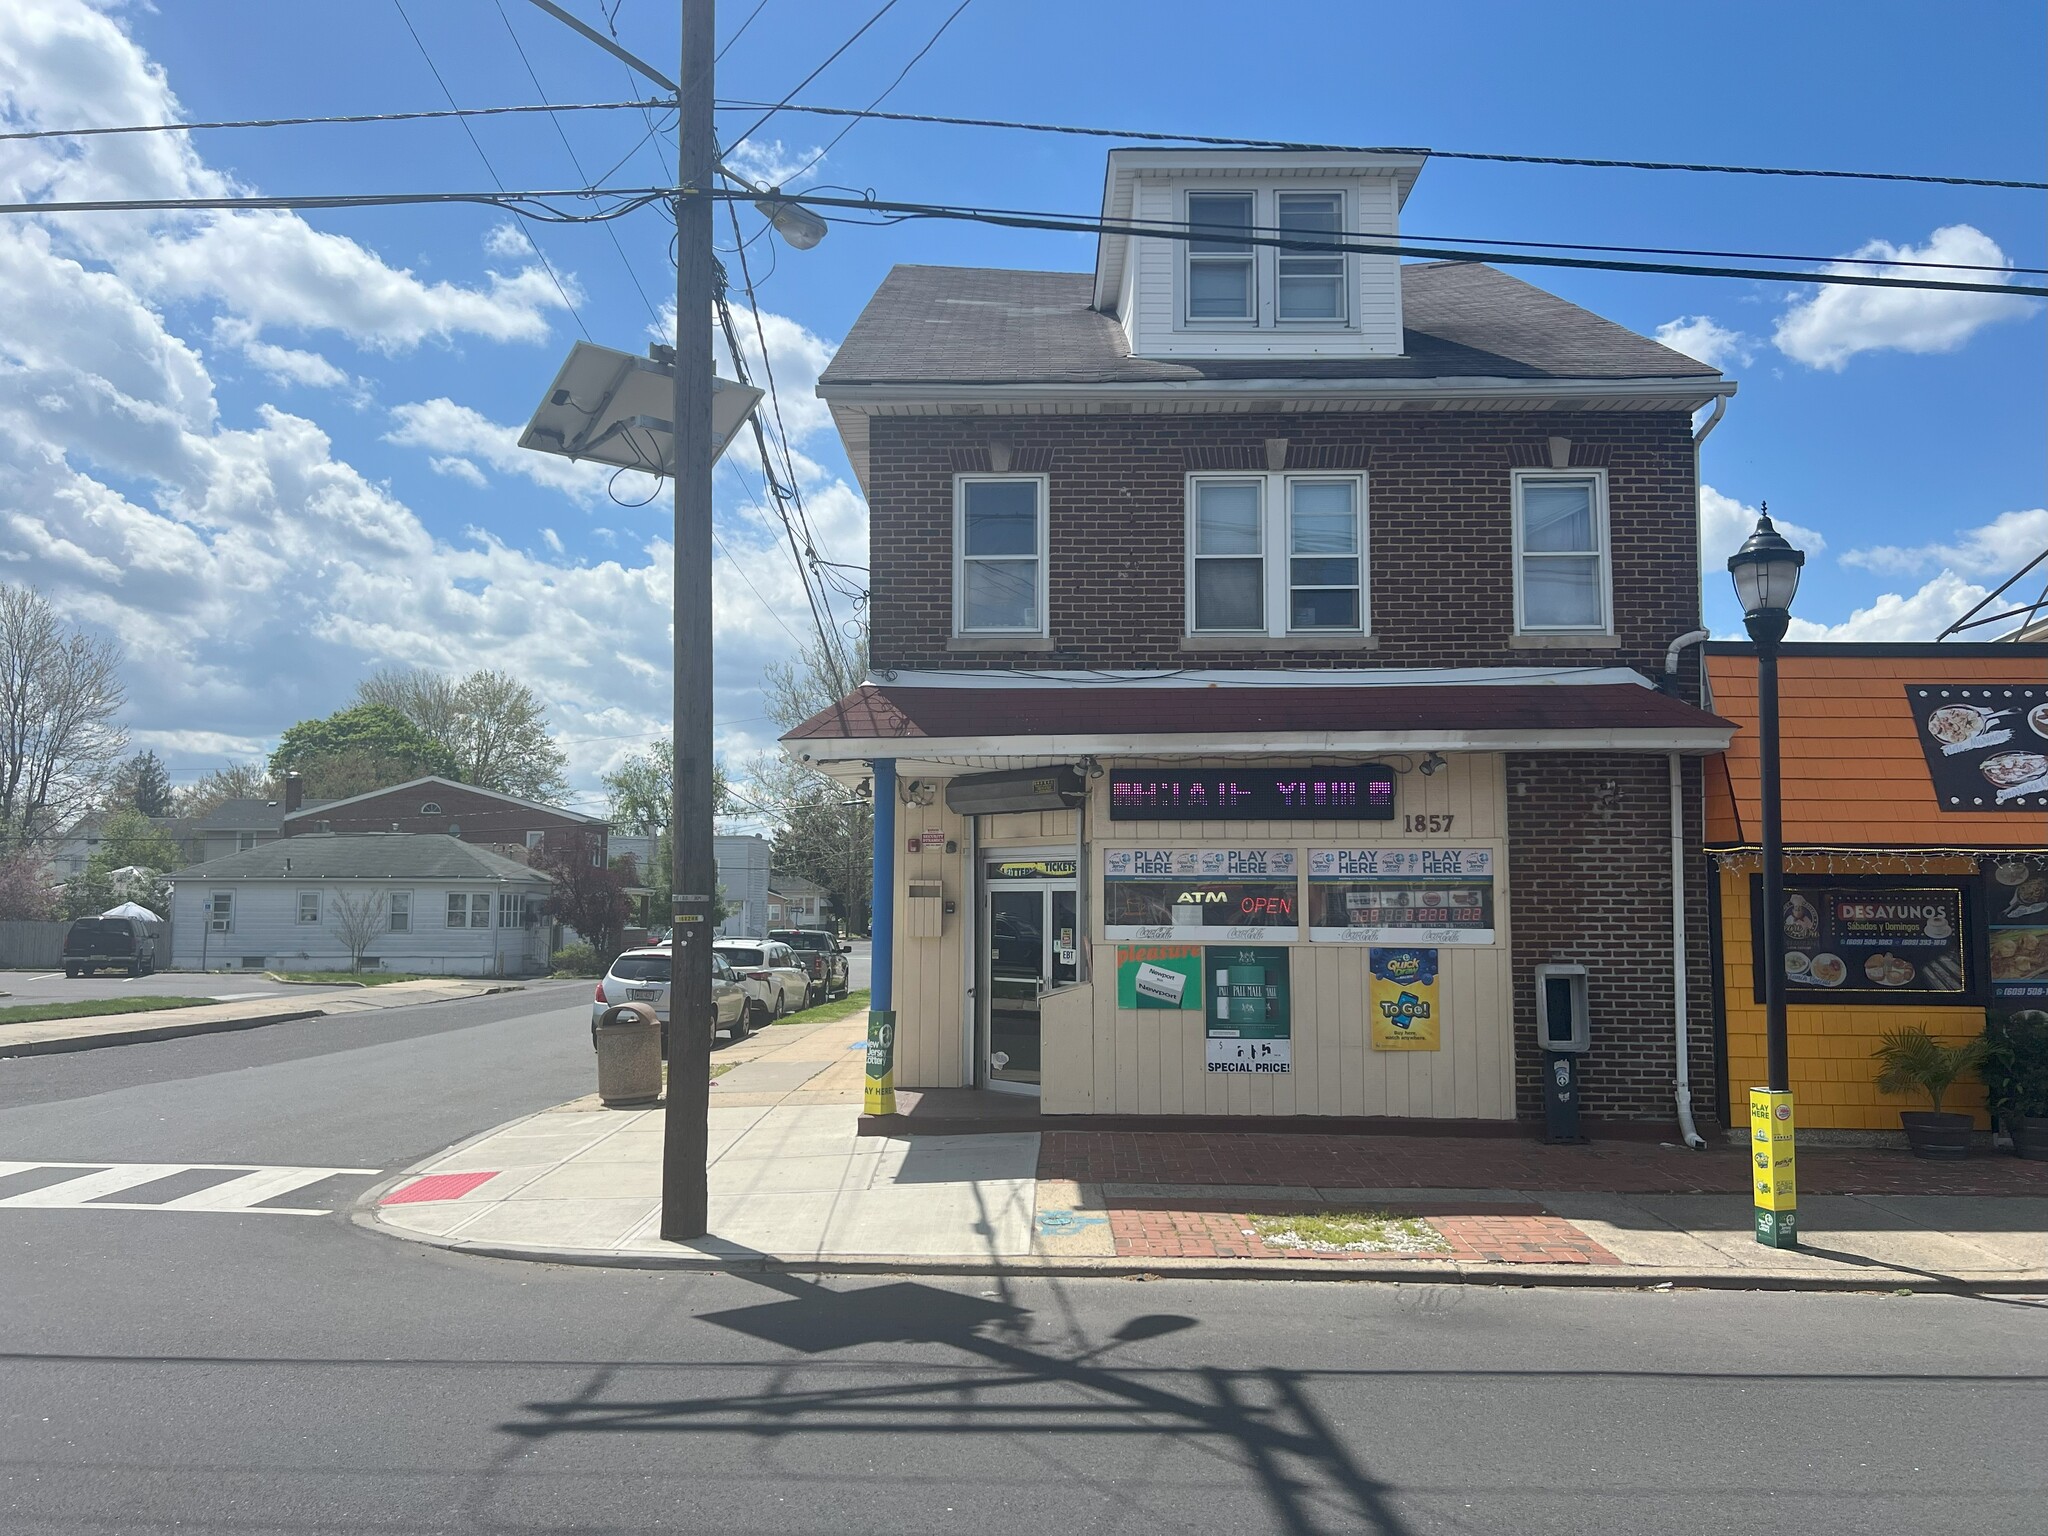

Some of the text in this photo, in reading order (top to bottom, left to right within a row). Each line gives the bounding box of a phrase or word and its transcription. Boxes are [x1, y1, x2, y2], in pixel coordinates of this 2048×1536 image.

[1405, 814, 1454, 833] 1857
[1135, 851, 1172, 862] PLAY
[1228, 851, 1267, 862] PLAY
[1338, 851, 1378, 862] PLAY
[1422, 851, 1462, 862] PLAY
[1044, 862, 1076, 872] TICKETS
[1135, 863, 1172, 873] HERE
[1228, 863, 1266, 873] HERE
[1338, 863, 1377, 873] HERE
[1422, 863, 1462, 873] HERE
[1177, 892, 1228, 903] ATM
[1241, 898, 1292, 914] OPEN
[1843, 905, 1946, 918] DESAYUNOS
[1847, 921, 1920, 932] Sábados y Domingos
[1063, 951, 1073, 959] EBT
[1149, 968, 1175, 980] Newport
[1139, 984, 1177, 999] Newport
[1233, 986, 1262, 997] PALL MALL
[2004, 988, 2026, 996] (609)
[1382, 1003, 1427, 1015] To Go!
[868, 1048, 887, 1058] Jersey
[1208, 1062, 1290, 1072] SPECIAL PRICE!
[1752, 1102, 1769, 1111] PLAY
[1752, 1110, 1770, 1119] HERE
